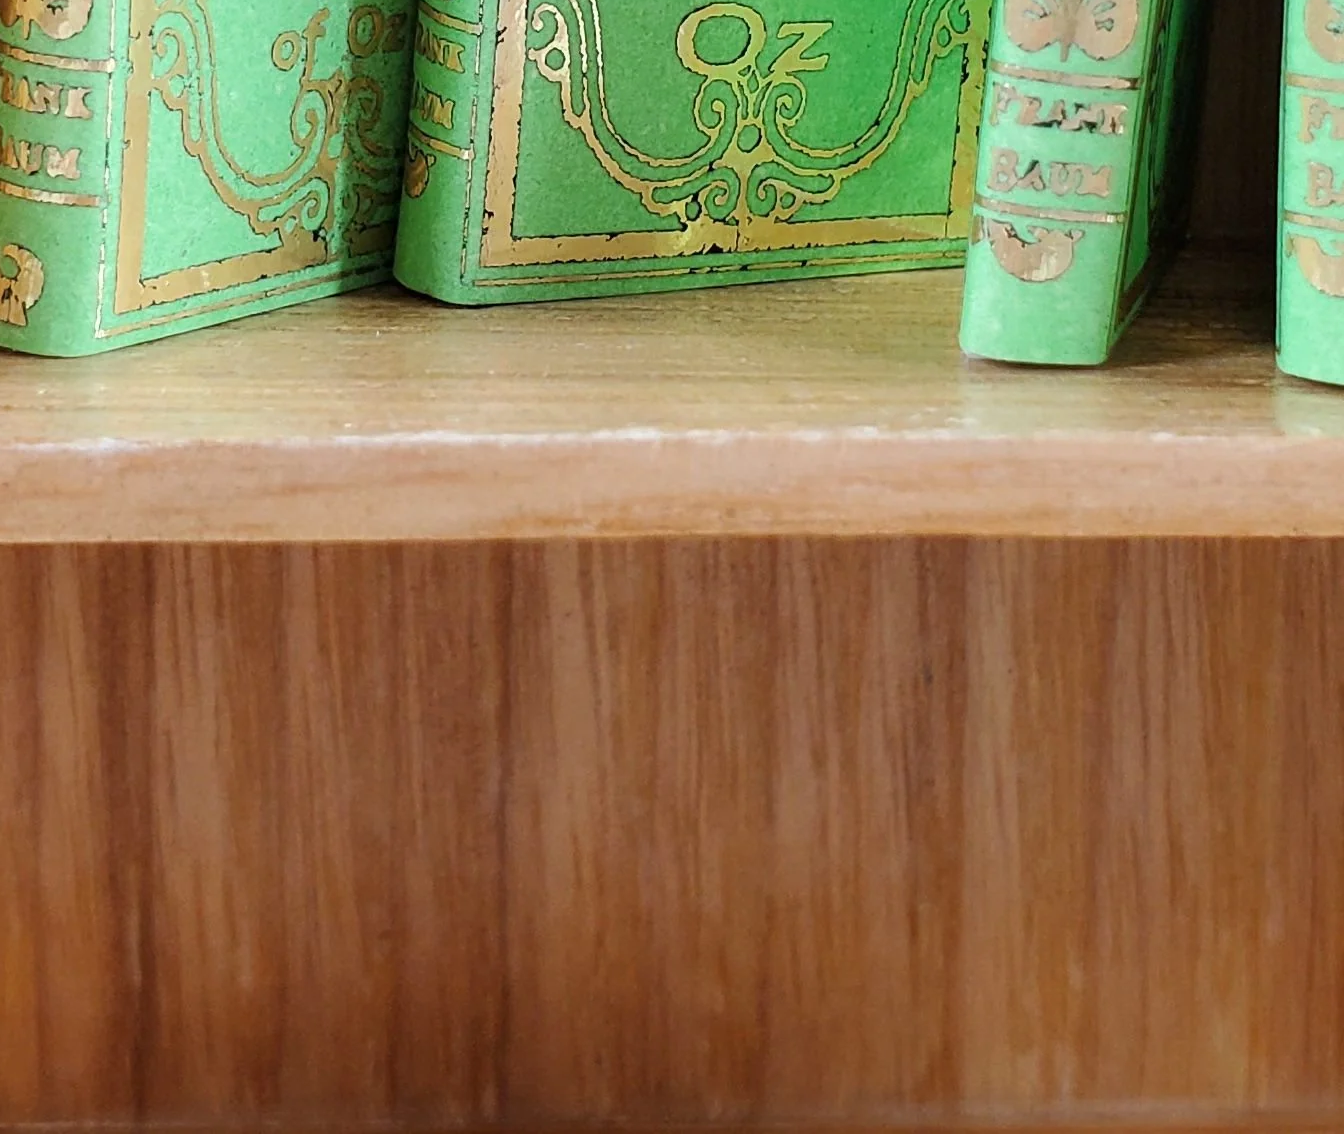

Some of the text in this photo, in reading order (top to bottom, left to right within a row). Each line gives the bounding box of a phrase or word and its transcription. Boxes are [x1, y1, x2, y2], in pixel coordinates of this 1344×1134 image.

[270, 5, 409, 84] of Oz
[675, 2, 835, 74] Oz
[989, 80, 1130, 136] FRANK
[986, 147, 1114, 199] BAUM
